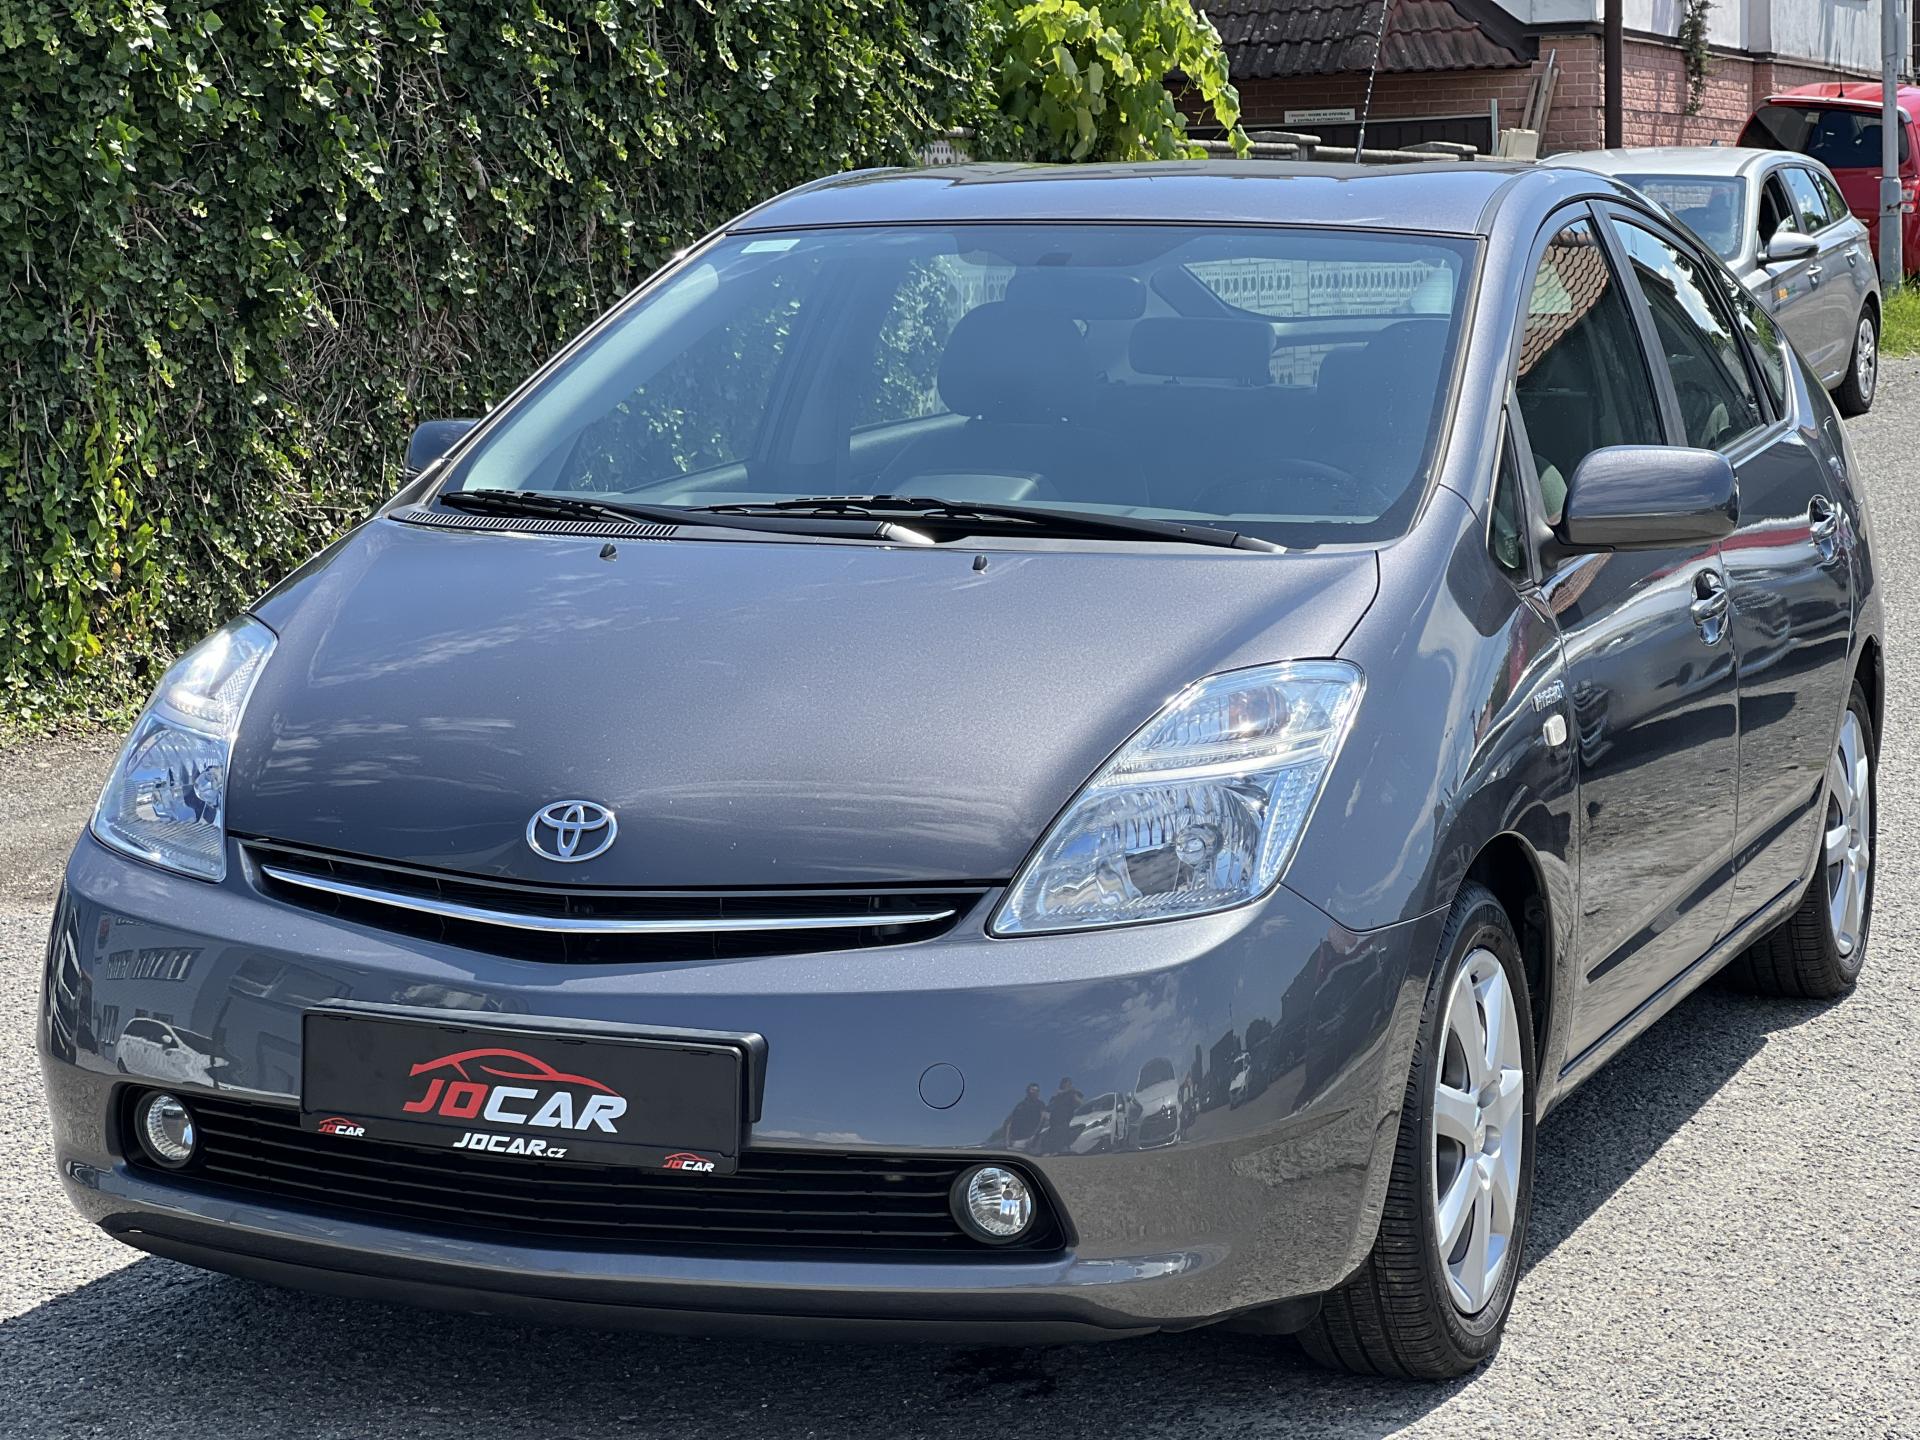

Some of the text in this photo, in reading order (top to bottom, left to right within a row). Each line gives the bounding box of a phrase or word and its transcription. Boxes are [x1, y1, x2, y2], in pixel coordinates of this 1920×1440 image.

[402, 1078, 628, 1133] JOCAR
[318, 1123, 365, 1137] JOCAR
[663, 1159, 715, 1173] JOCAR
